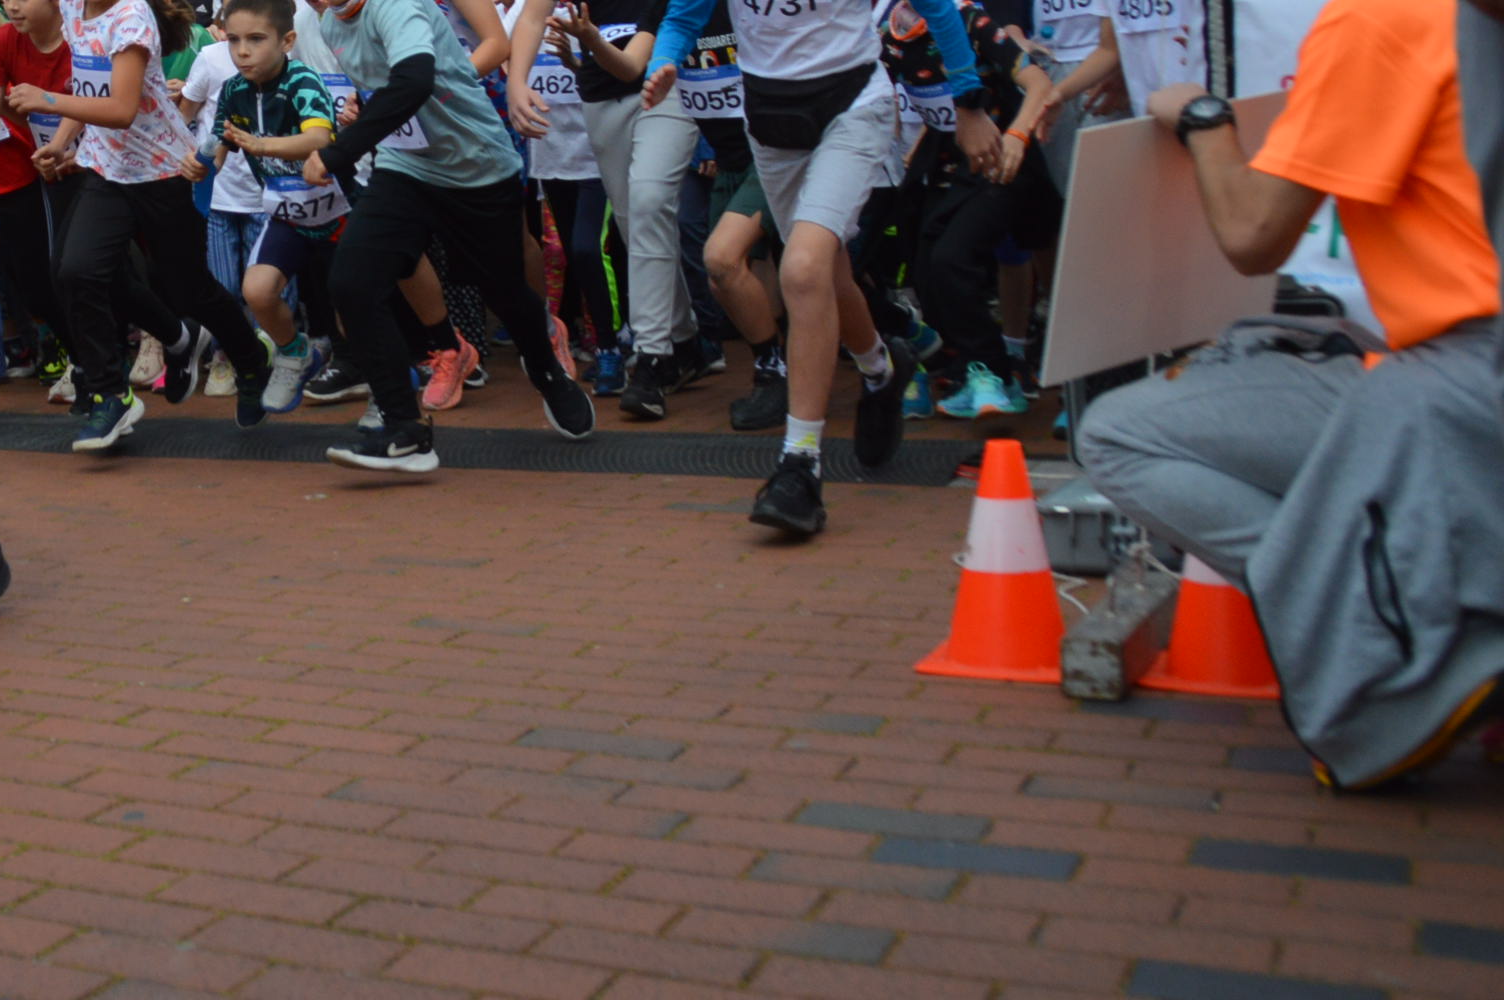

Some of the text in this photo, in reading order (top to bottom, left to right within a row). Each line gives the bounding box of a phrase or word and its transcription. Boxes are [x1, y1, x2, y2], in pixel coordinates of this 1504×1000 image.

[531, 75, 580, 94] 462
[680, 88, 741, 111] 5055
[274, 192, 335, 221] 4377
